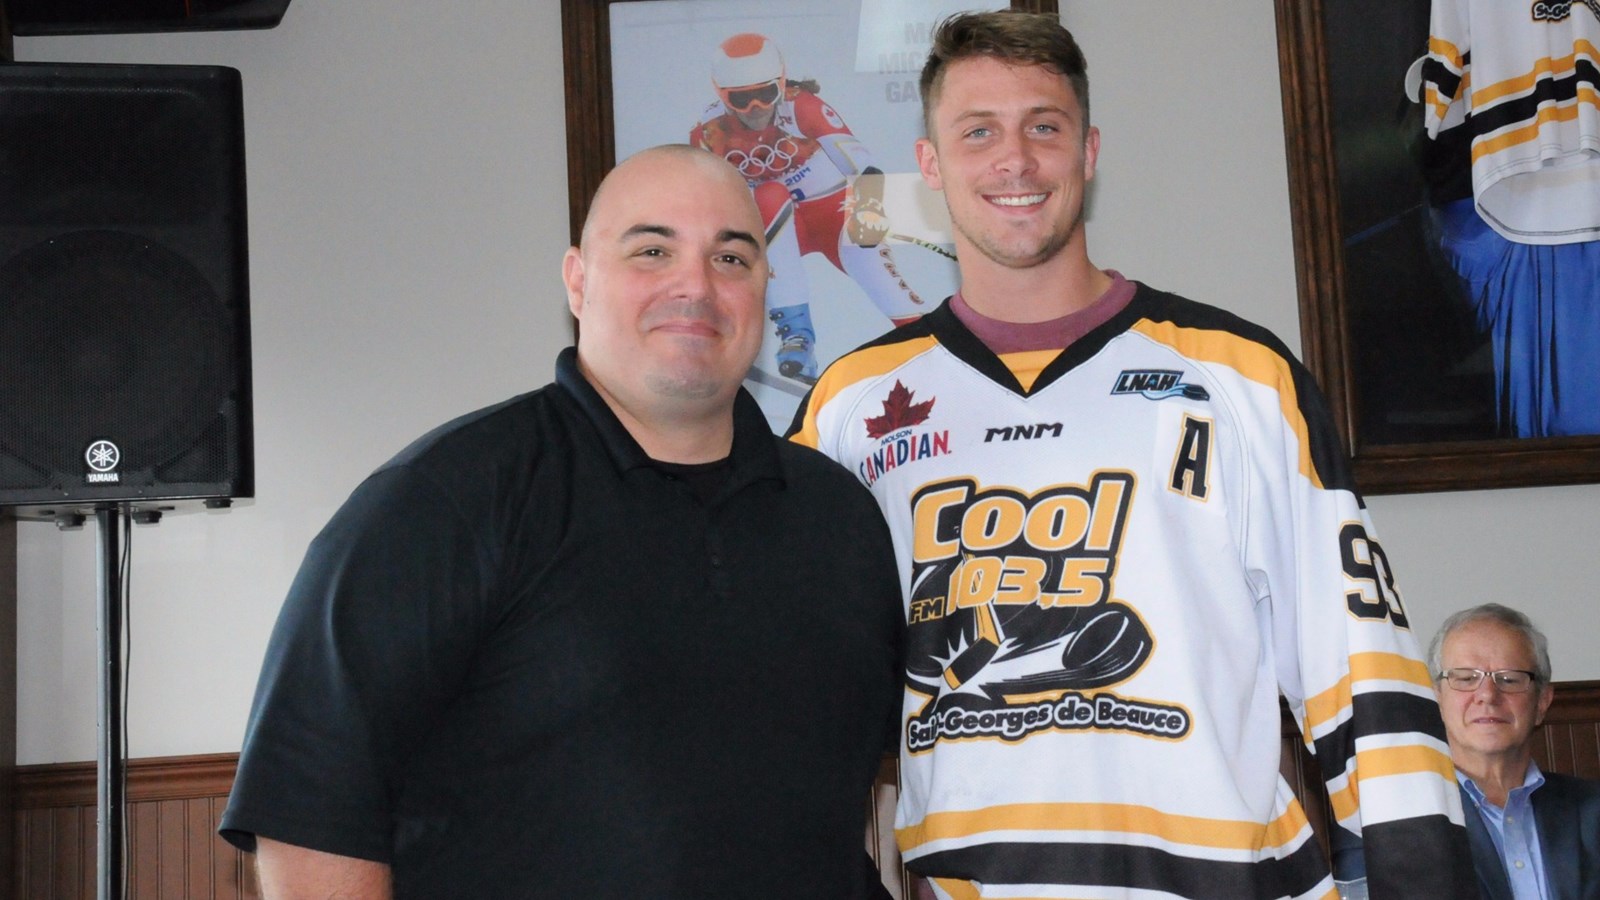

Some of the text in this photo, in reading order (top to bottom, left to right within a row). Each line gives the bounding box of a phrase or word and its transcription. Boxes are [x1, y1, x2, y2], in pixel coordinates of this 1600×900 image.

[1115, 373, 1178, 392] LNAH
[880, 429, 912, 446] MOLSON
[984, 422, 1063, 443] MNM
[1169, 413, 1213, 501] A
[88, 473, 119, 482] YAMAHA
[912, 479, 1127, 563] Cool
[909, 596, 945, 624] FM
[1057, 696, 1093, 723] de
[1097, 700, 1185, 732] Beauce
